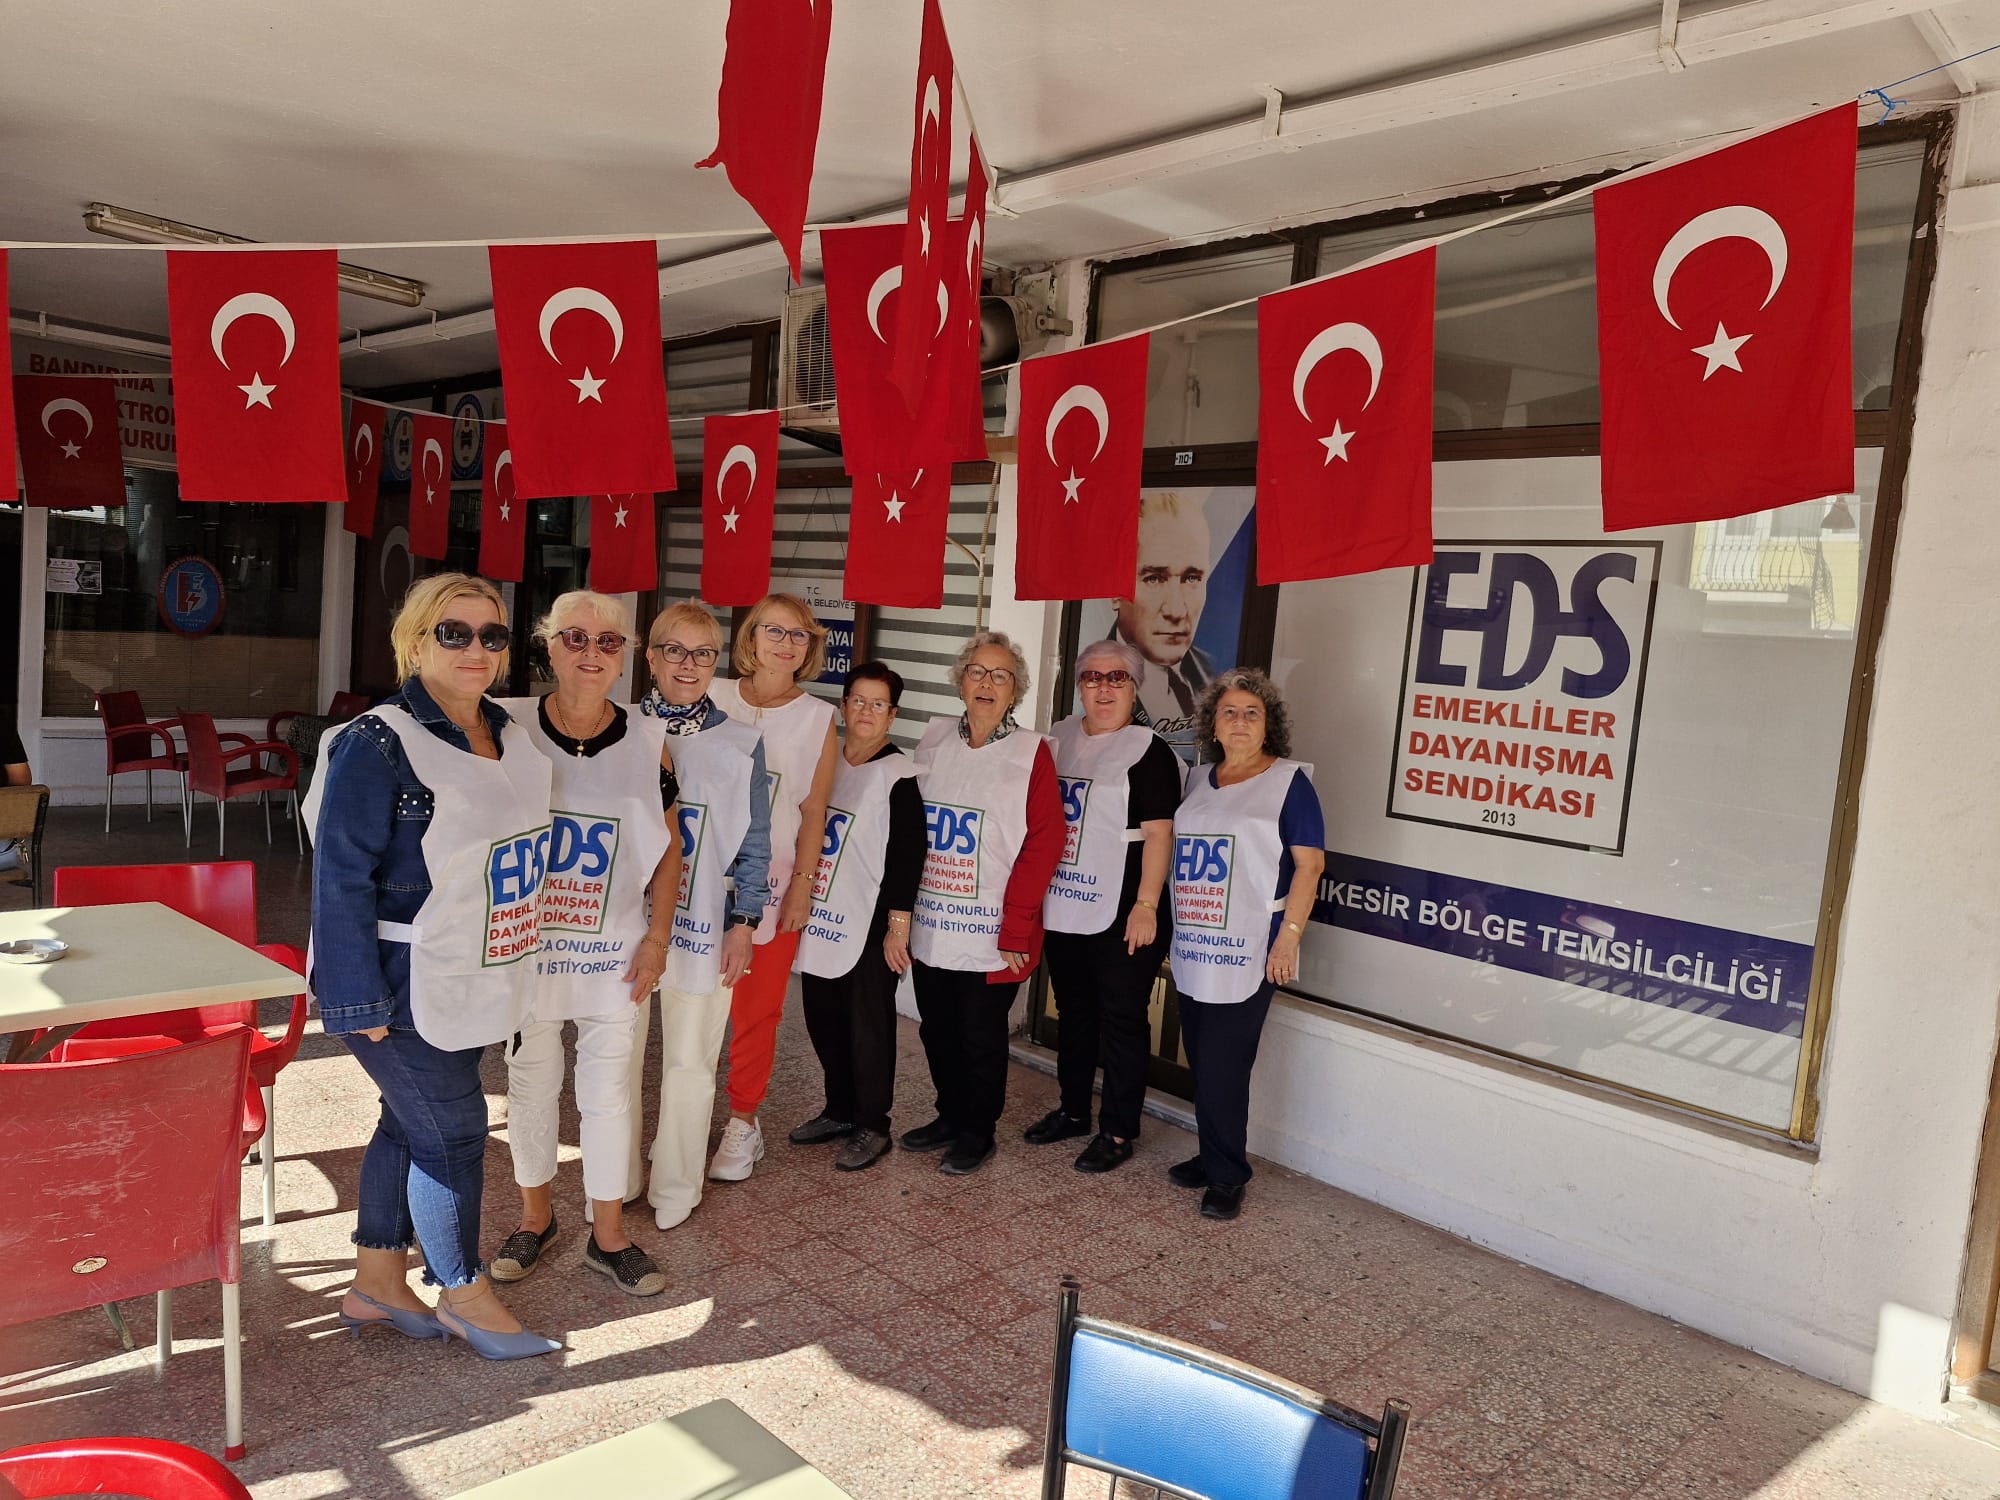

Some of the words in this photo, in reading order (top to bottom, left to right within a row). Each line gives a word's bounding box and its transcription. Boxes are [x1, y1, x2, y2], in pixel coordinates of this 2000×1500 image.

[1415, 552, 1637, 699] EDS
[1412, 694, 1616, 738] EMEKLİLER
[1408, 731, 1614, 780] DAYANIŞMA
[1404, 768, 1596, 819] SENDİKASI
[924, 805, 978, 855] EDS
[1482, 809, 1516, 827] 2013
[490, 831, 549, 905] EDS
[1175, 838, 1229, 883] EDS
[947, 904, 999, 918] ONURLU
[1176, 885, 1225, 897] EMEKLİLER
[1176, 898, 1223, 911] DAYANIŞMA
[555, 938, 624, 954] ONURLU
[674, 915, 711, 935] URLU
[1197, 935, 1245, 948] ONURLU
[1315, 878, 1410, 921] IKESİR
[1418, 899, 1527, 947] BÖLGE
[1537, 925, 1782, 1004] TEMSİLCİLİĞİ
